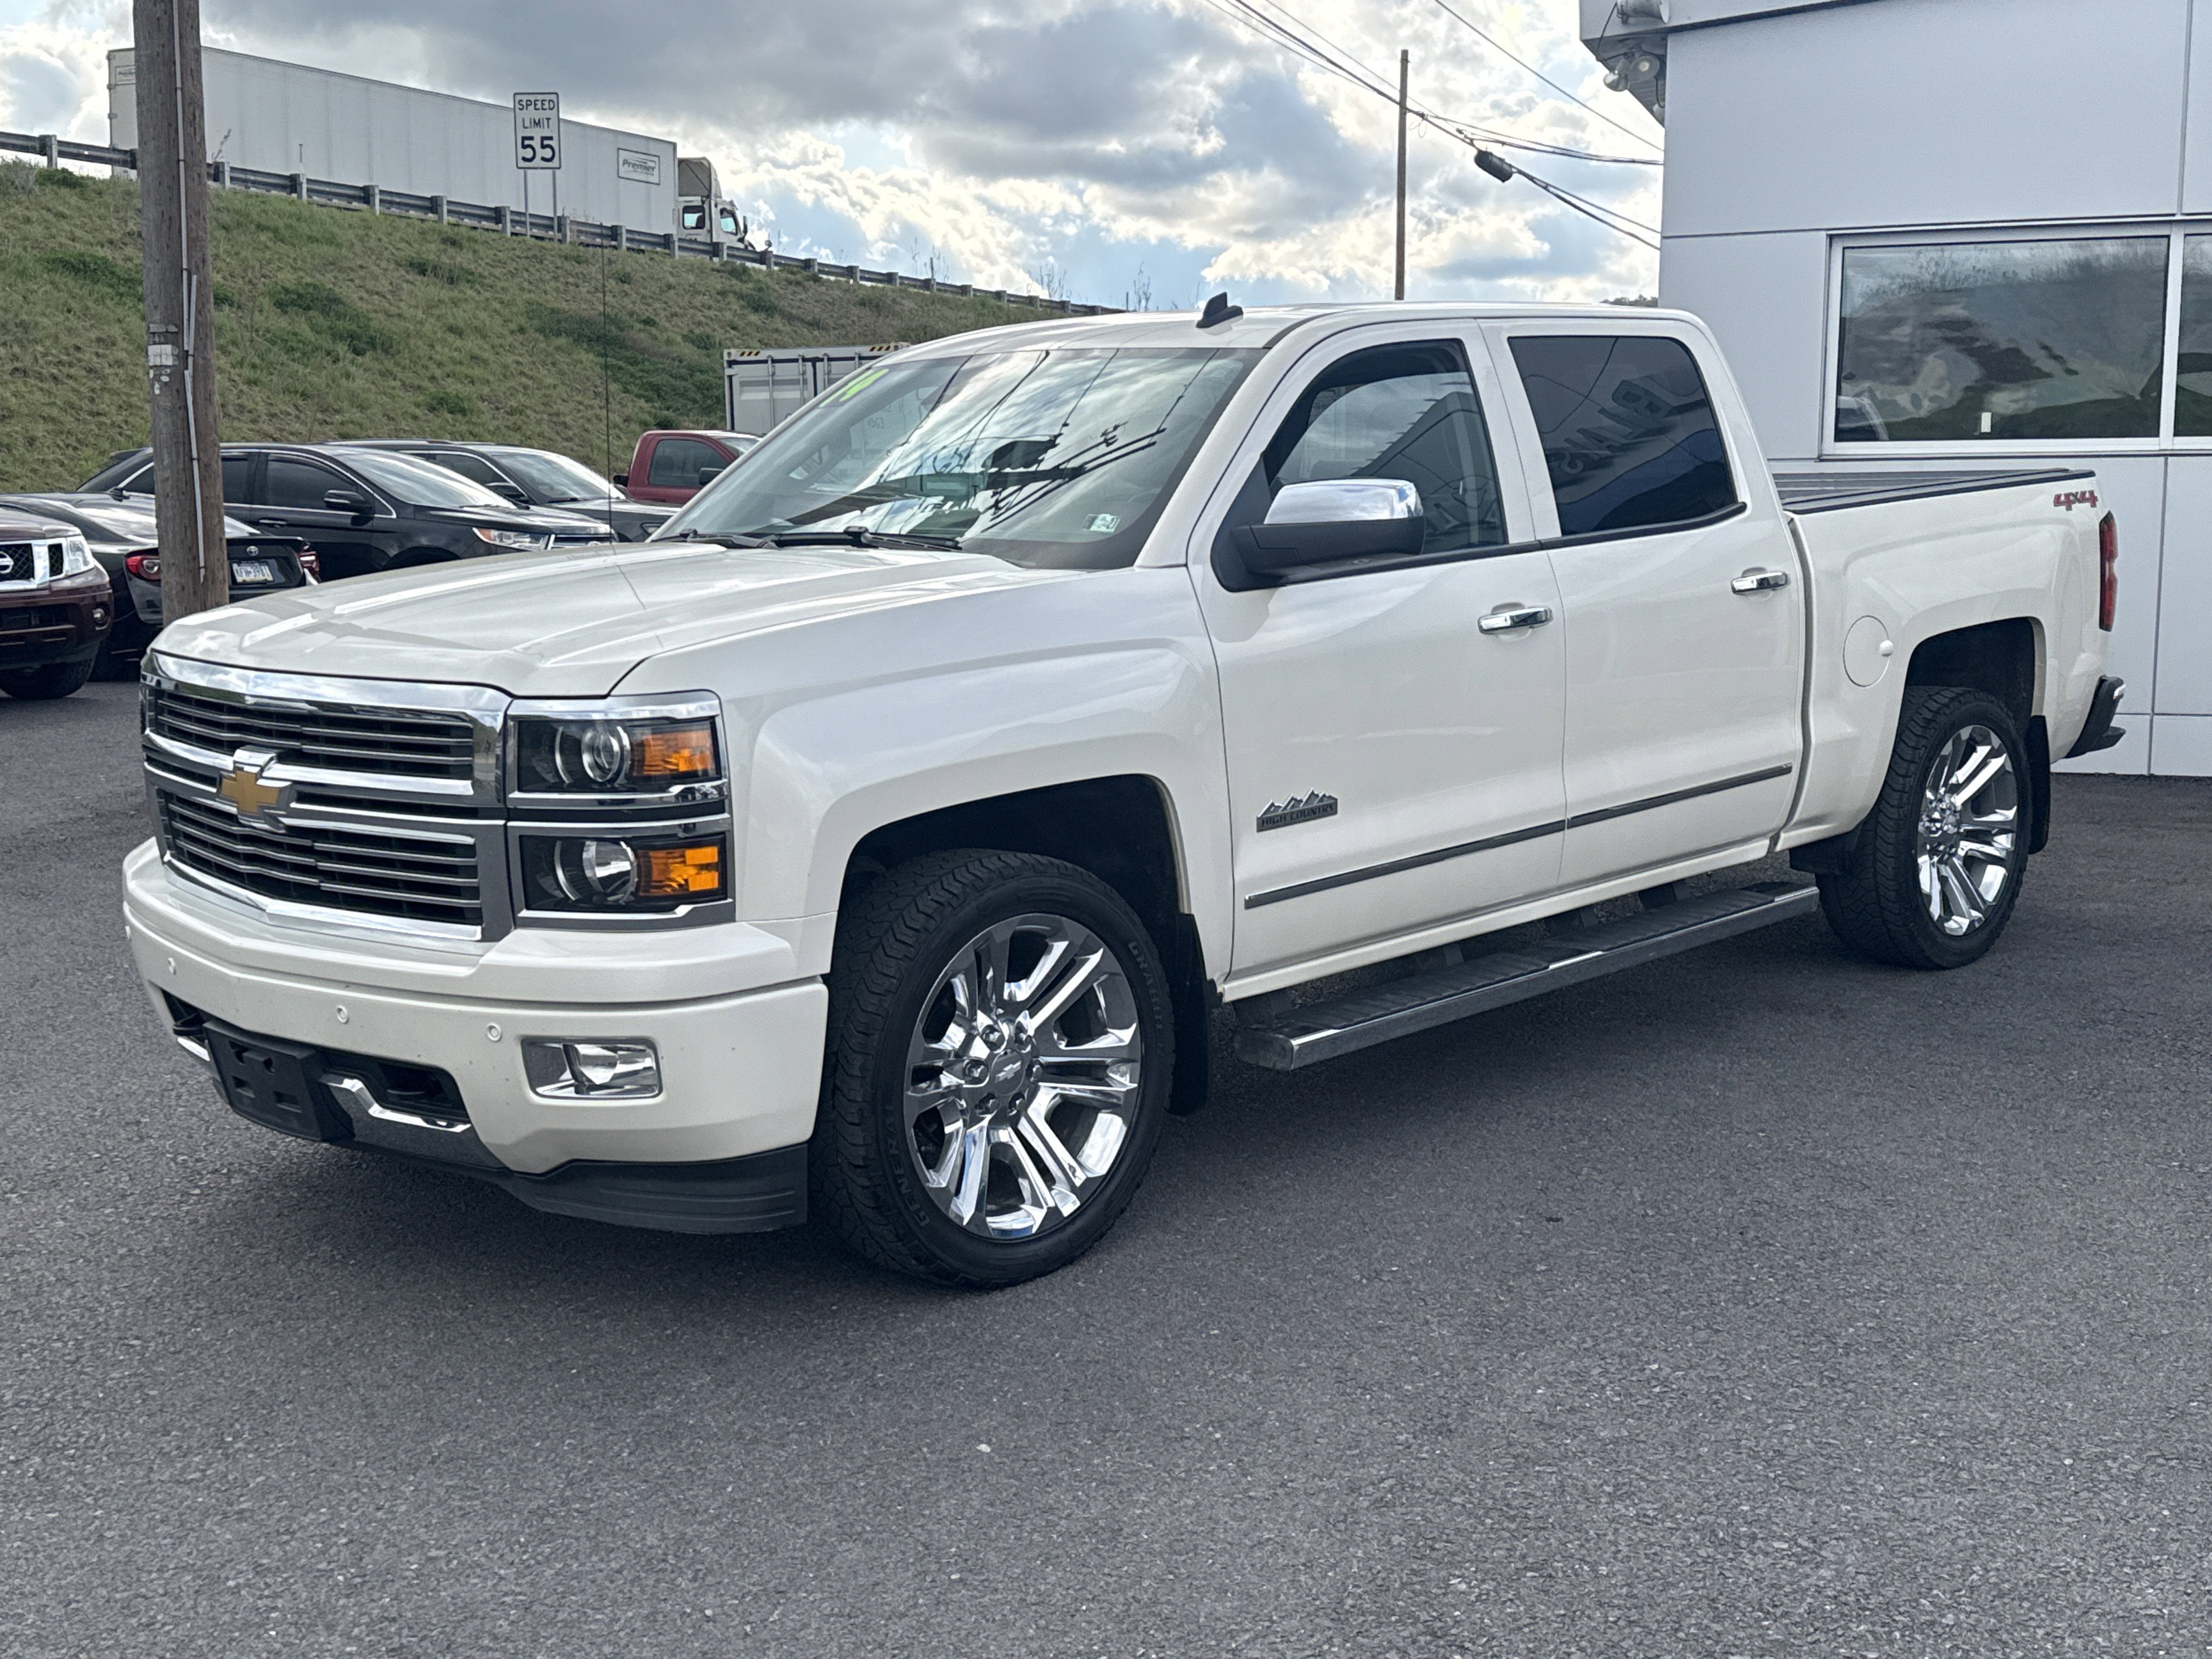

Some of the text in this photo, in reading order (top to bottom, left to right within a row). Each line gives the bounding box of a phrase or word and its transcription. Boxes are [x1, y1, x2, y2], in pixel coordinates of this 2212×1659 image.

[518, 99, 555, 110] SPEED
[522, 117, 551, 129] LIMIT
[521, 136, 555, 162] 55
[1262, 804, 1334, 827] HIGH COUNTRY
[883, 1102, 930, 1227] GENERAL
